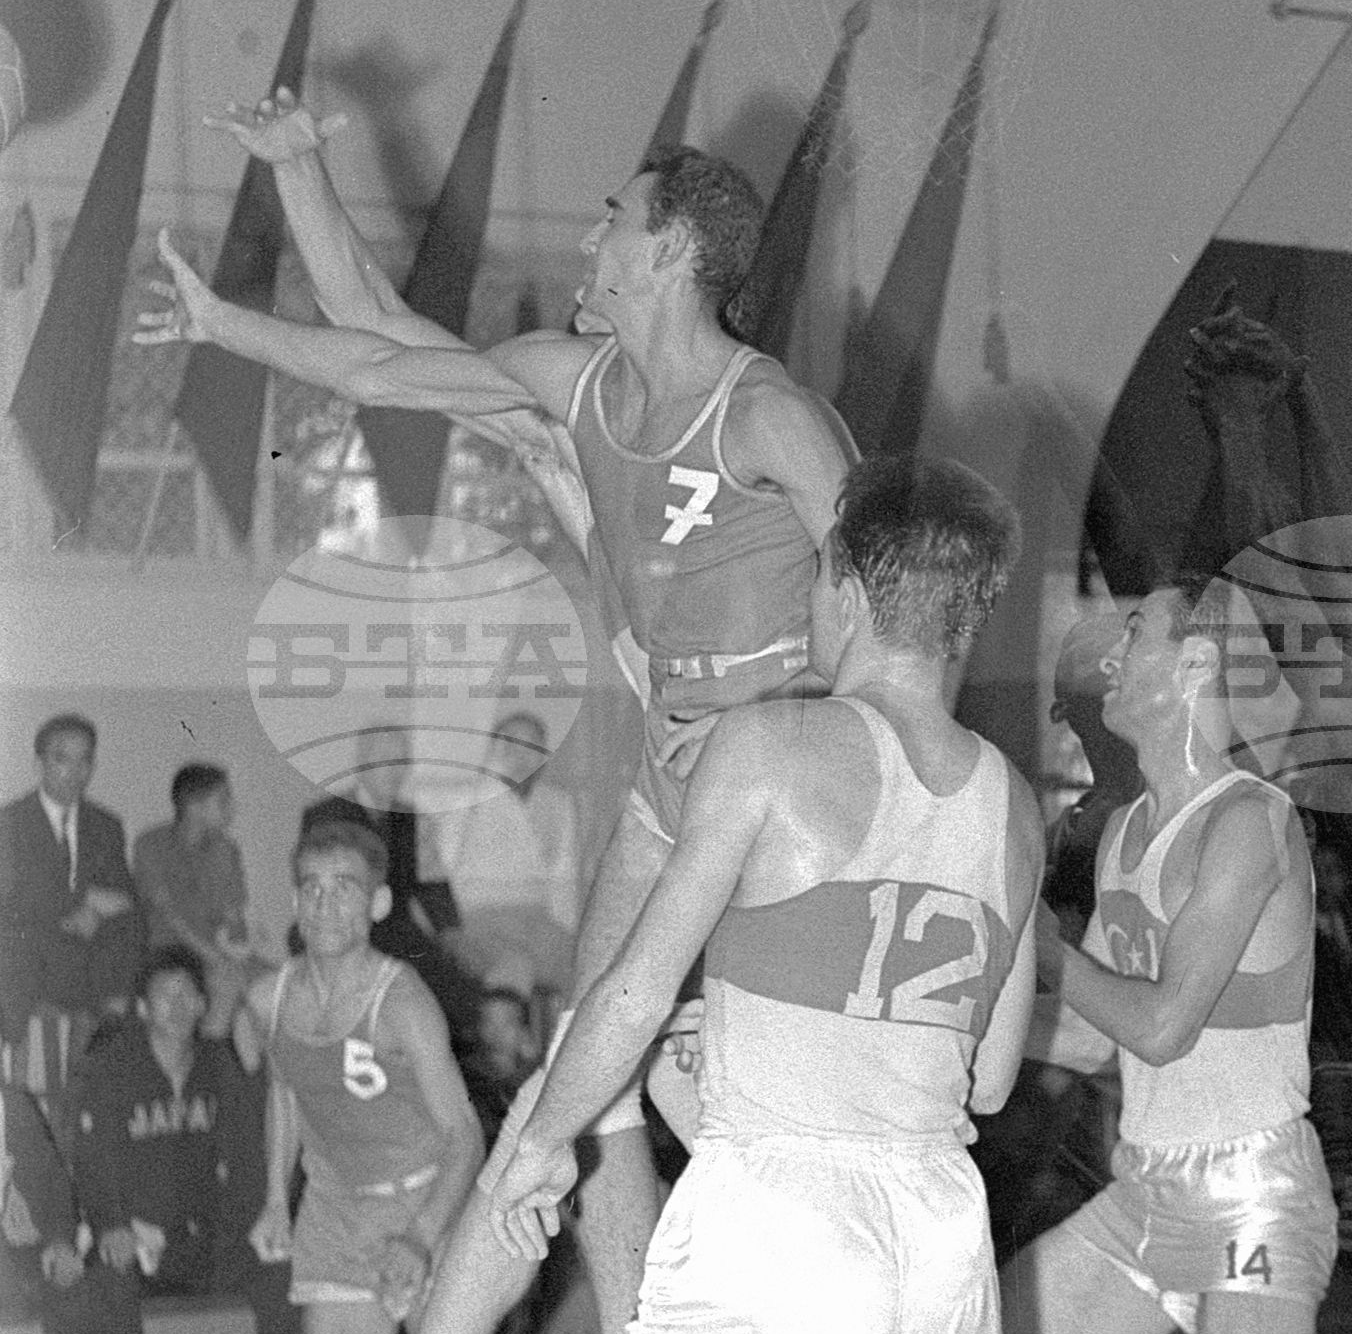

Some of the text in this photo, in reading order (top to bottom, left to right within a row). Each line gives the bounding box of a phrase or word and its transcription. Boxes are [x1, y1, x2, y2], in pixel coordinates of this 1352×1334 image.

[660, 465, 719, 545] 7
[843, 882, 988, 1030] 12
[343, 1038, 387, 1100] 5
[1226, 1240, 1272, 1285] 14
